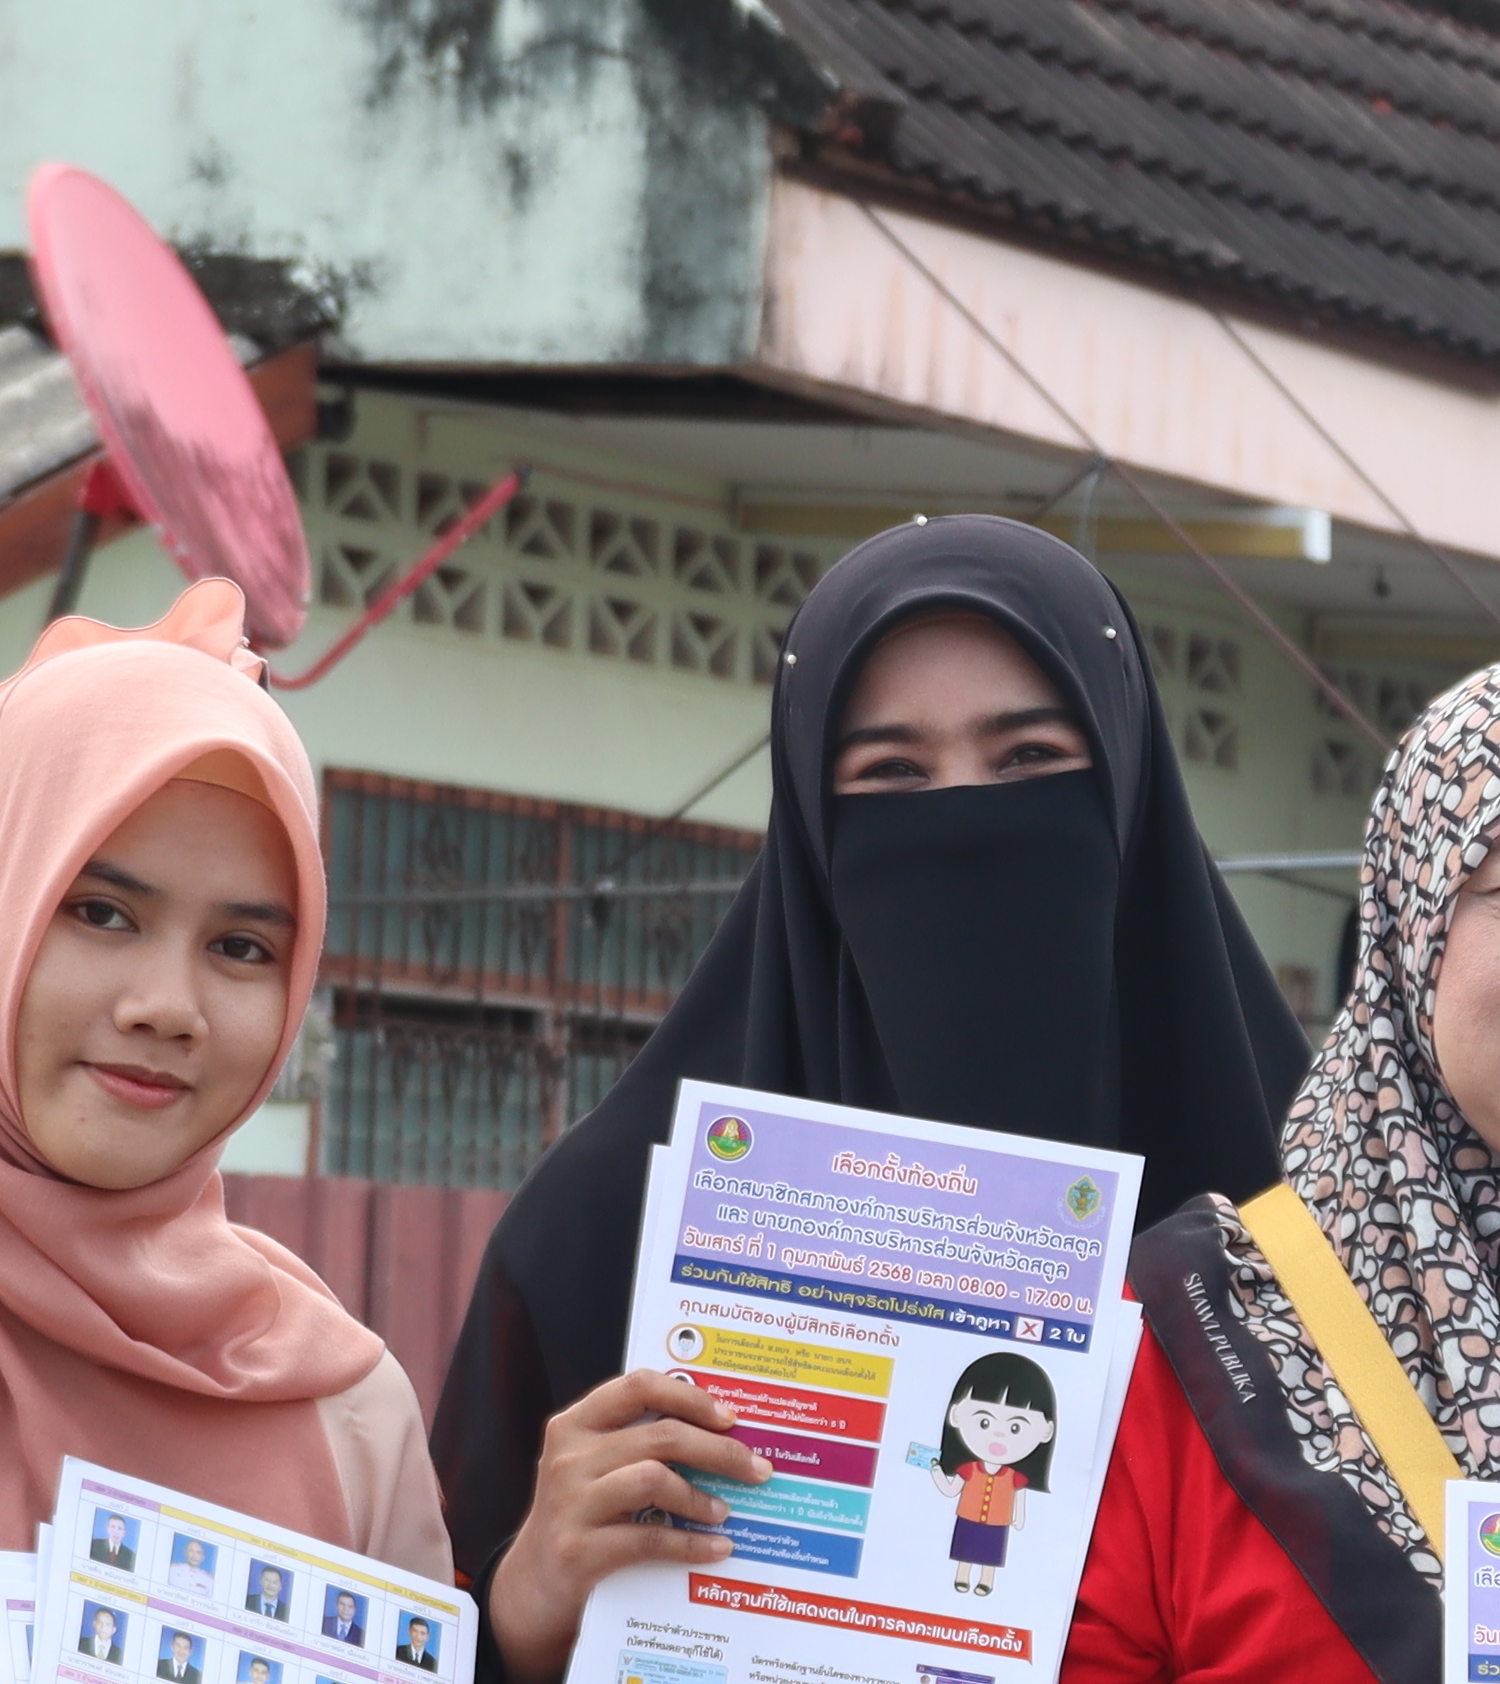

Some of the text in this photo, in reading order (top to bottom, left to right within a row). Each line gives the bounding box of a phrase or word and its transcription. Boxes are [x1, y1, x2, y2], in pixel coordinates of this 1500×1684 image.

[829, 1151, 977, 1196] เลือกตั้งท้องถิ่น
[683, 1224, 745, 1254] วันเสาร์
[746, 1235, 763, 1258] ที่
[780, 1247, 866, 1275] กุมภาพันธ์
[867, 1260, 913, 1283] 2568
[916, 1269, 955, 1290] เวลา
[958, 1274, 1008, 1298] 08.00
[1025, 1285, 1073, 1309] 17.00
[1075, 1295, 1093, 1314] น.
[715, 1203, 1070, 1283] และ นายกองค์การบริหารส่วนจังหวัดสตูล
[681, 1261, 1084, 1343] ร่วมกันใช้สิทธิ อย่างสุจริตโปร่งใส เข้าคูหา 2 ใบ
